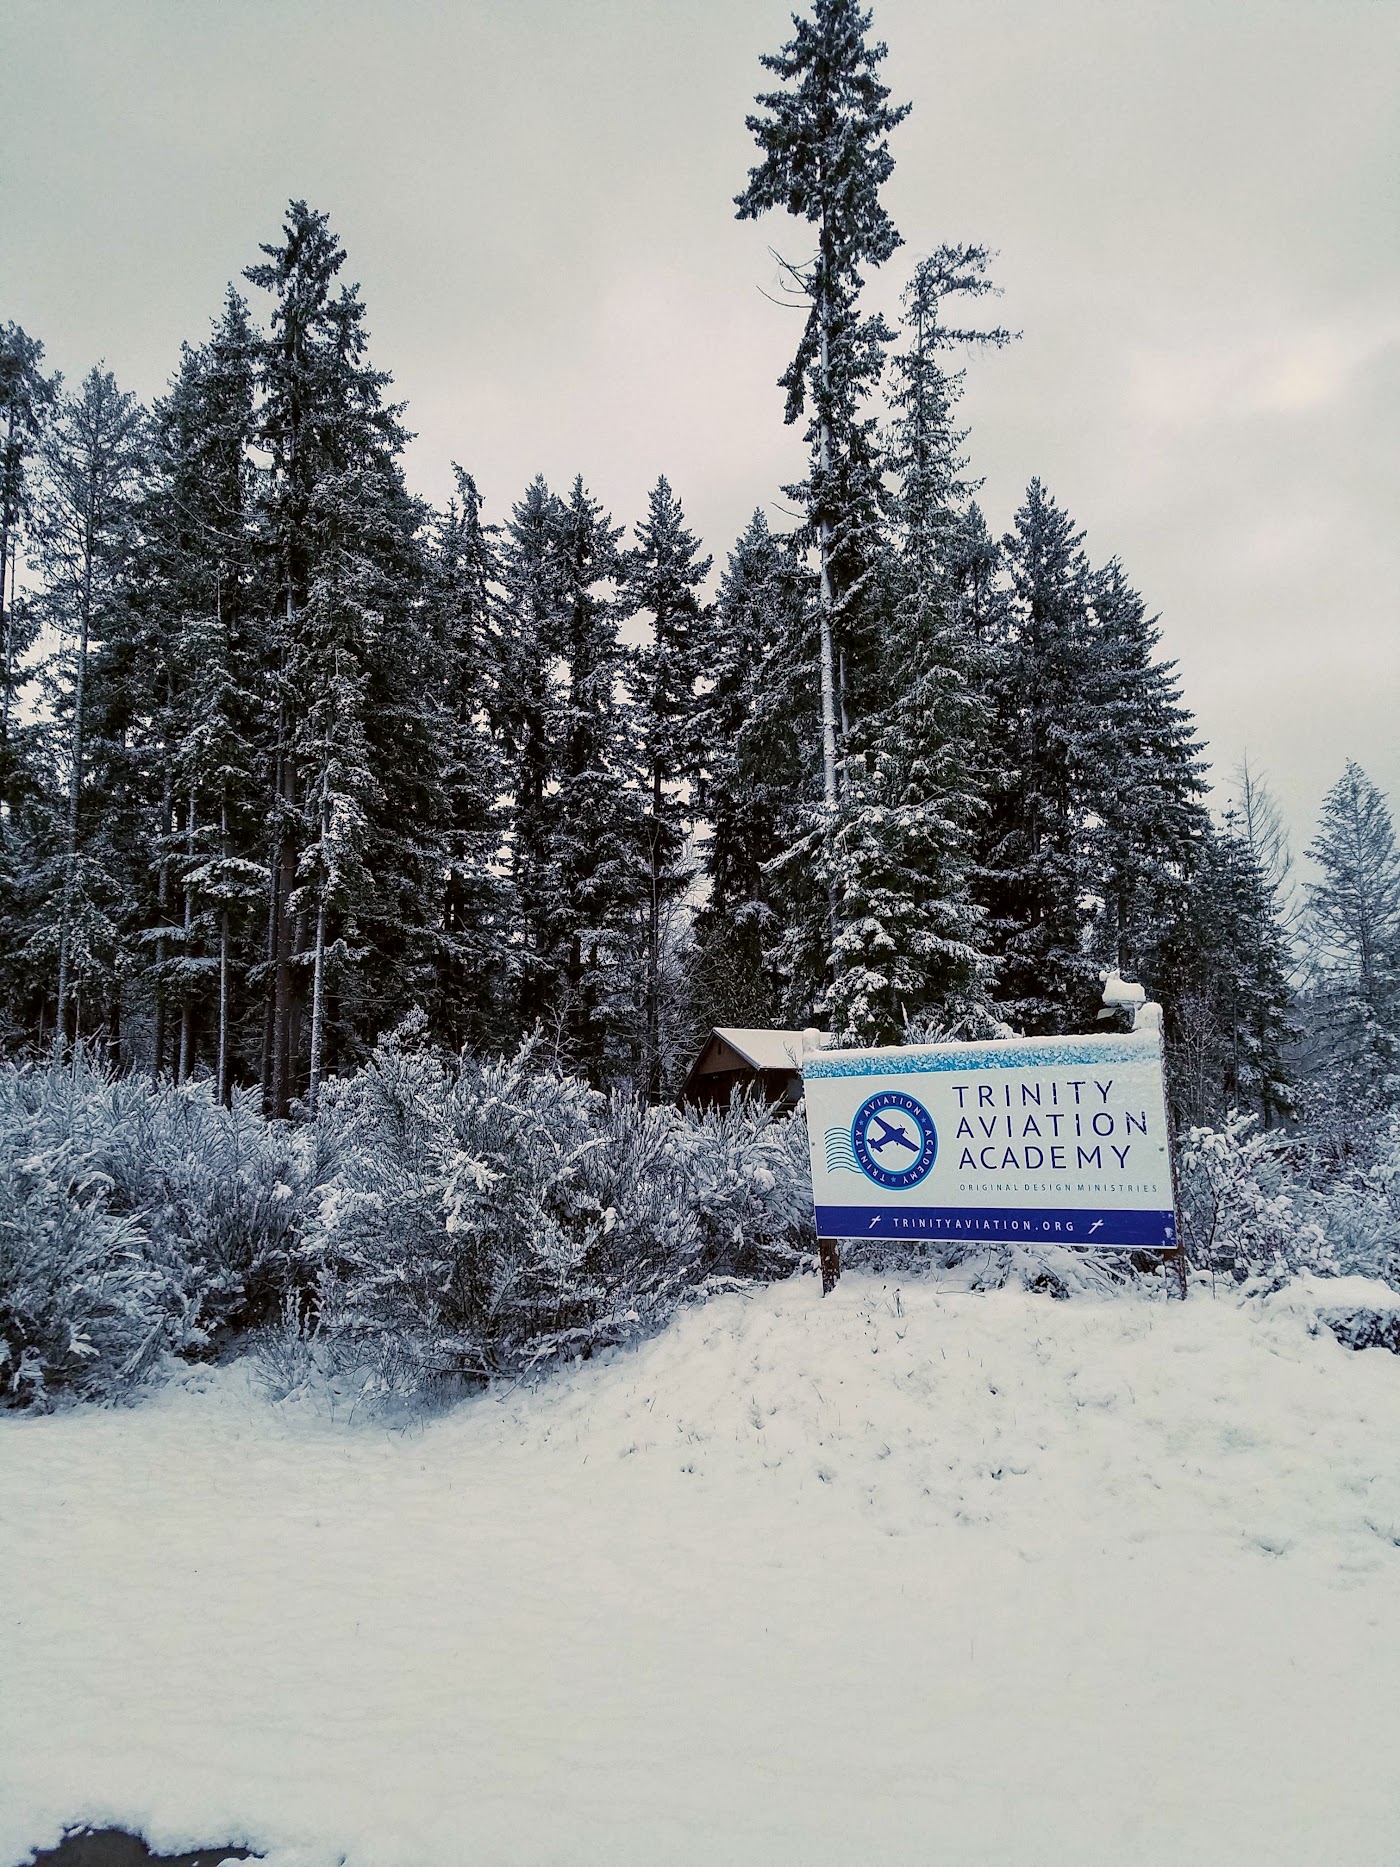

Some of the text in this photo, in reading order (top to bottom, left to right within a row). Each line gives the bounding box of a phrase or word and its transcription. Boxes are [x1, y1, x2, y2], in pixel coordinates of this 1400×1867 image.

[863, 1095, 922, 1117] AVIATION
[952, 1079, 1114, 1108] TRINITY
[956, 1111, 1148, 1139] AVIATION
[857, 1129, 886, 1183] TRINITY
[902, 1129, 934, 1185] ACADEMY
[958, 1145, 1132, 1170] ACADEMY
[959, 1183, 1158, 1194] ORIGINAL DESIGN MINISTRIES
[893, 1217, 1075, 1232] TRINITYAVIATION.ORG
